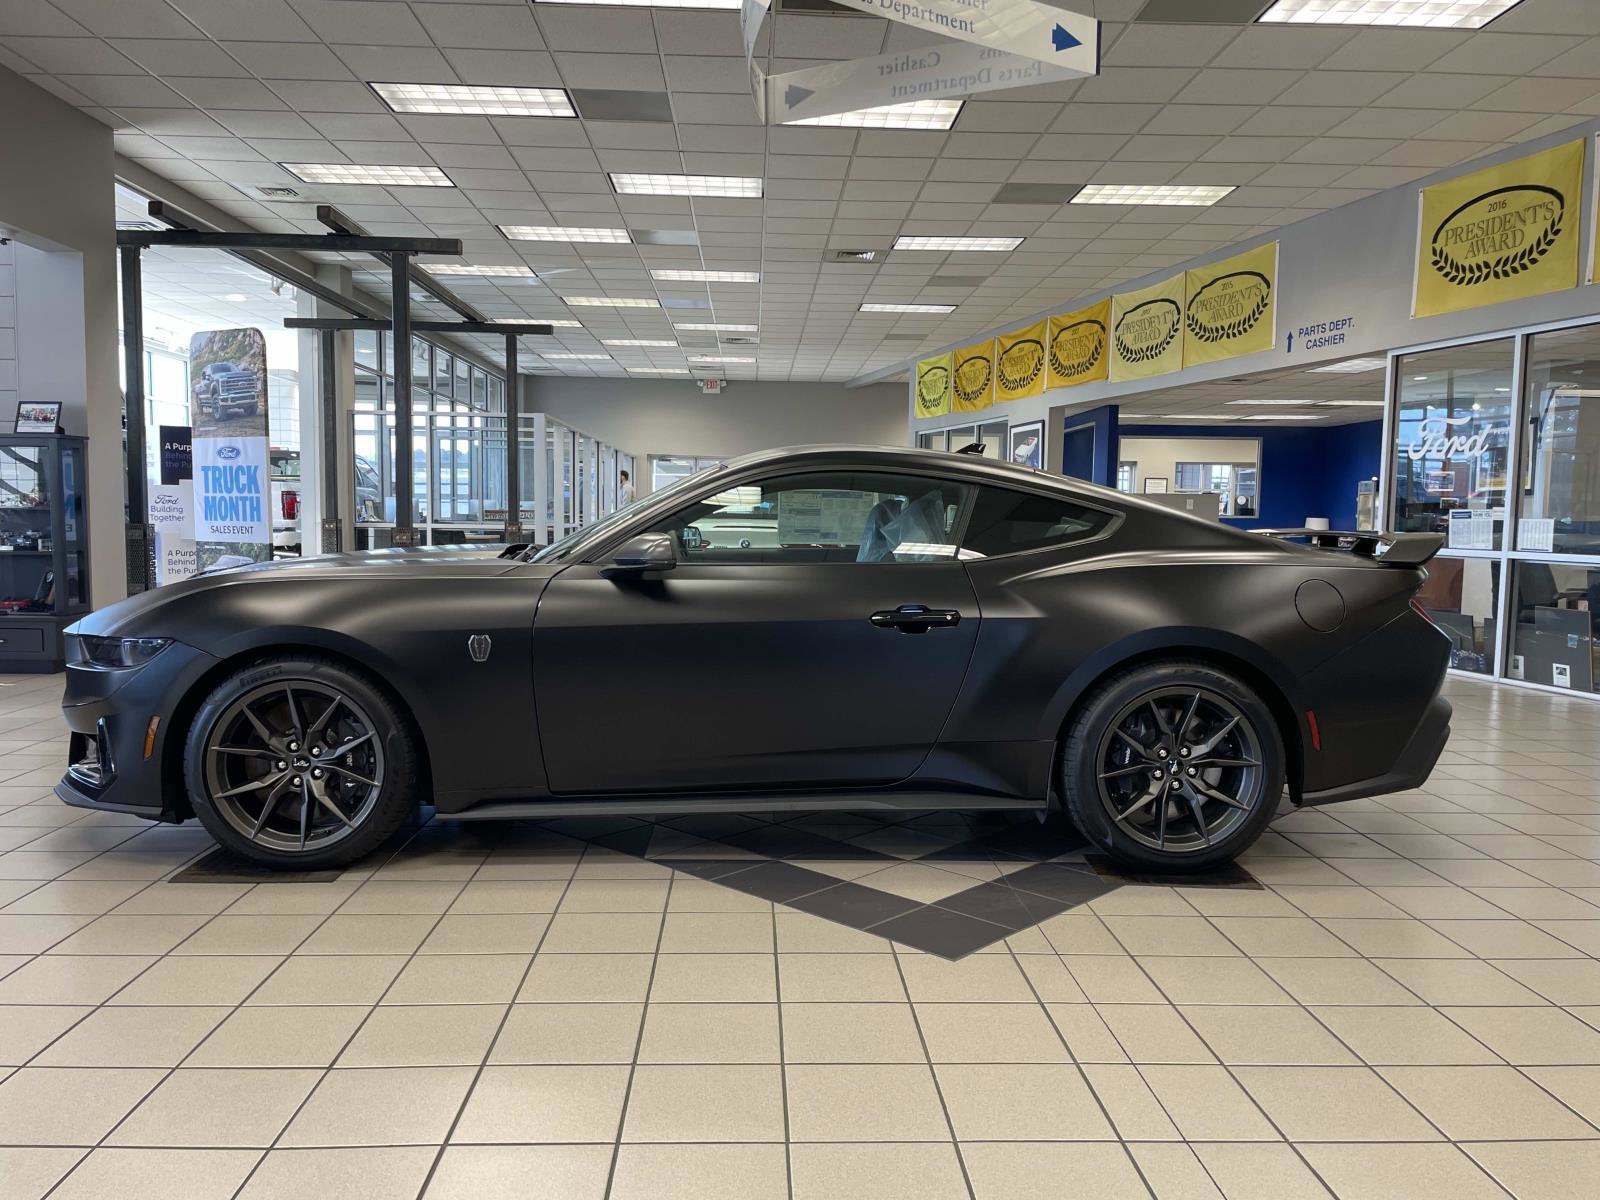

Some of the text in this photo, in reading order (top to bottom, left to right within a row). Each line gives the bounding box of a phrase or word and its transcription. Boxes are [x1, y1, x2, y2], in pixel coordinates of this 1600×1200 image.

[880, 0, 975, 33] Department
[1488, 200, 1507, 213] 2016
[1443, 201, 1555, 247] PRESIDENT'S
[1464, 229, 1525, 260] AWARD
[1208, 303, 1244, 323] AWARD
[1299, 317, 1355, 338] PARTS DEPT.
[1306, 333, 1345, 350] CASHIER
[1408, 416, 1492, 460] Ford
[165, 442, 171, 450] A
[219, 446, 238, 458] Ford
[201, 465, 261, 495] TRUCK
[155, 494, 179, 505] Ford
[150, 505, 184, 515] Building
[204, 495, 262, 522] MONTH
[149, 513, 184, 523] Together
[211, 525, 254, 535] SALES EVENT
[168, 558, 196, 566] Behind
[168, 567, 182, 575] the
